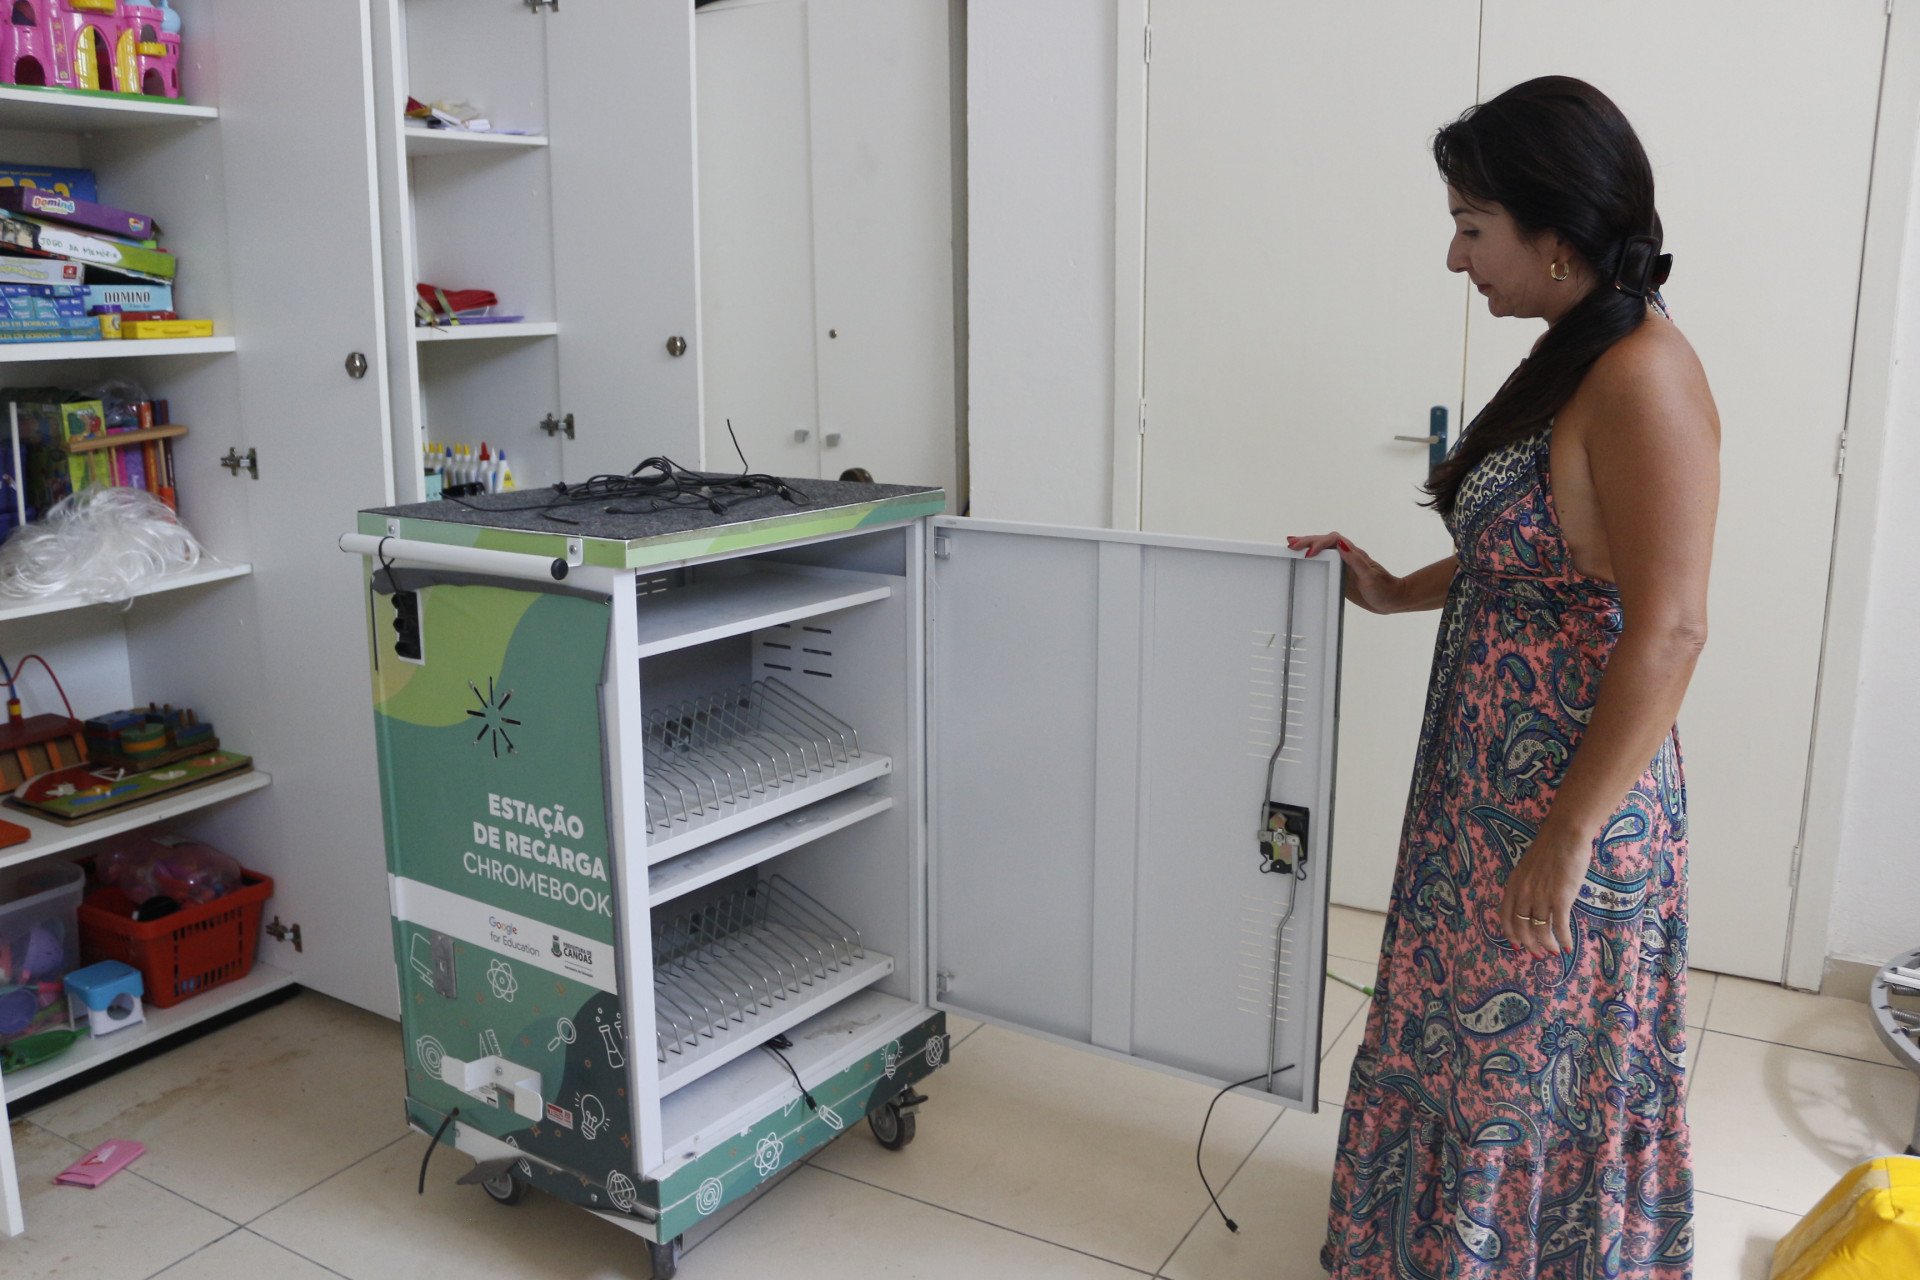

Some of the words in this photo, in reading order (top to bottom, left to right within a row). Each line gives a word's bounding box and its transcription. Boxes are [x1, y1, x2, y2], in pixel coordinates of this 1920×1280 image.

[40, 237, 63, 248] JOGO
[488, 792, 584, 839] ESTAÇÃO
[473, 821, 501, 850] DE
[505, 830, 607, 882] RECARGA
[463, 851, 612, 917] CHROMEBOOK
[488, 915, 518, 936] Google
[490, 931, 501, 944] for
[502, 935, 540, 957] Education
[563, 947, 593, 965] CANOAS
